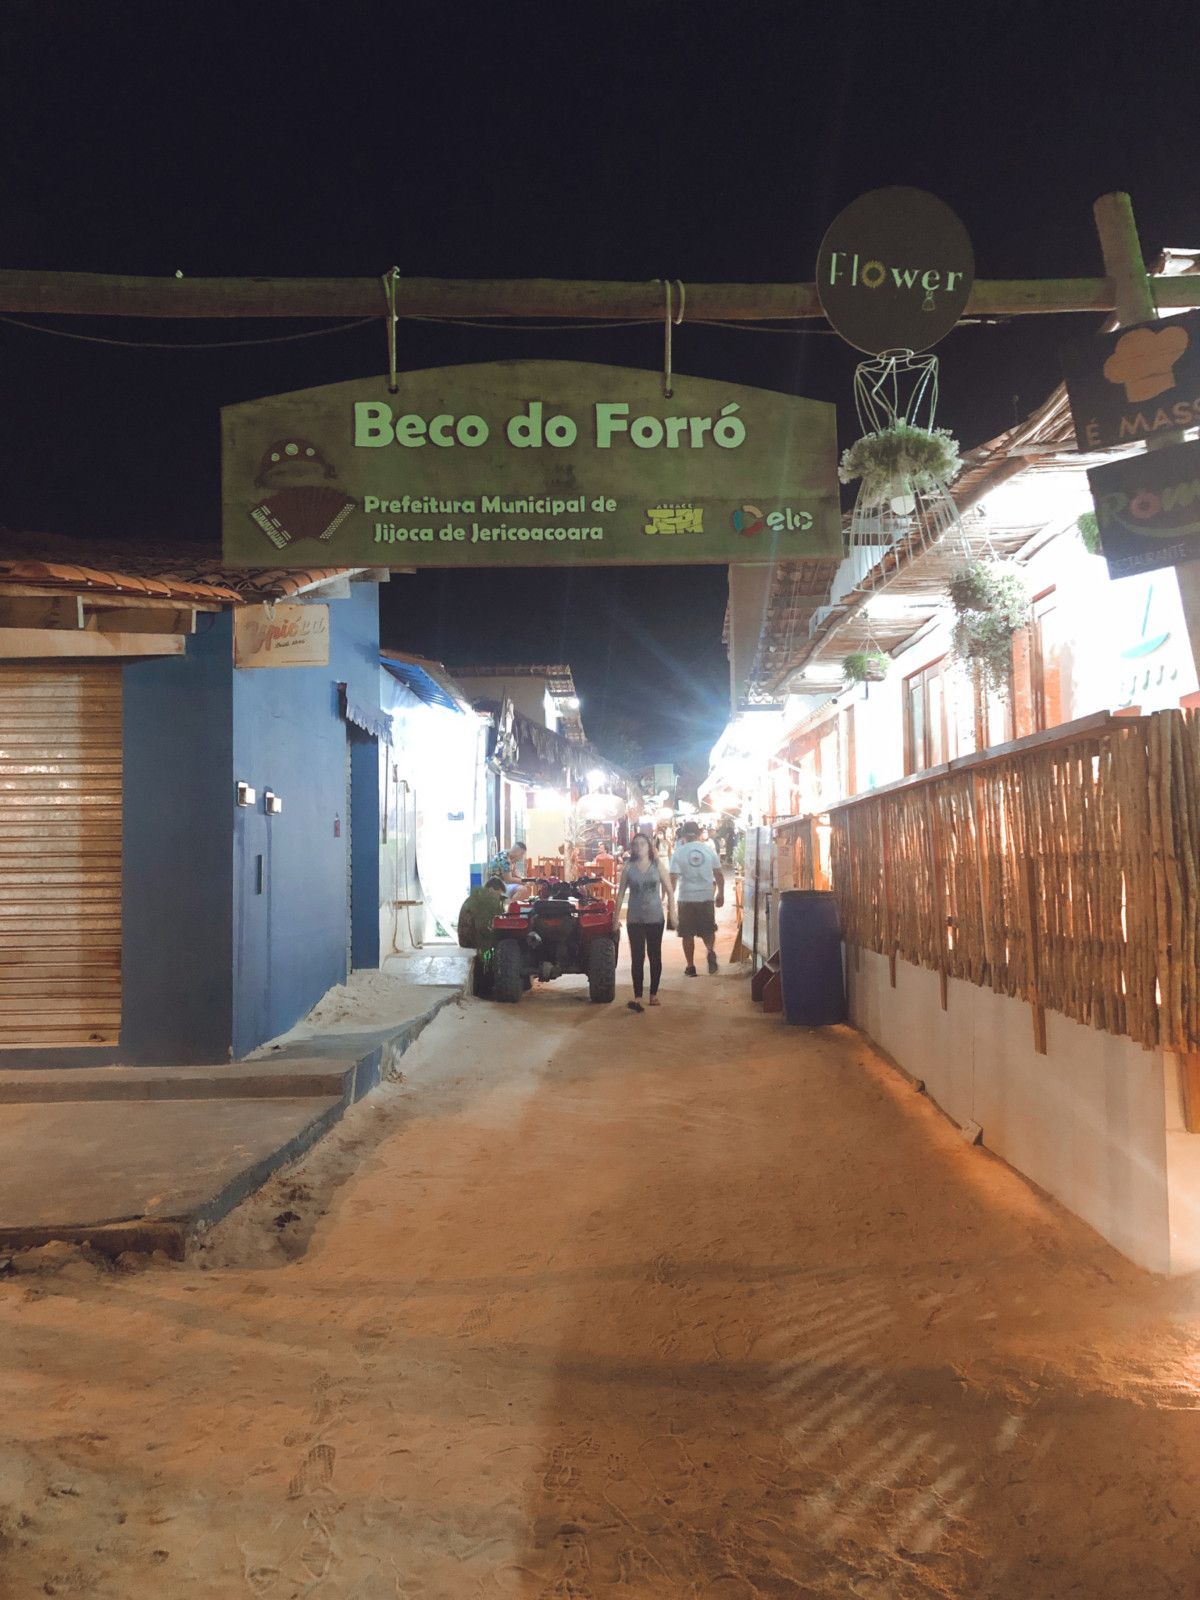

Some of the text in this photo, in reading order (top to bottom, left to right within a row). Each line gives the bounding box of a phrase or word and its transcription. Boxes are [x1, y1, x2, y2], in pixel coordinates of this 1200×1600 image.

[829, 252, 963, 292] Flower
[354, 401, 746, 449] Beco do Forró
[364, 495, 617, 516] Prefeitura Municipal de
[766, 507, 814, 532] elo
[374, 523, 604, 544] Jijoca de Jericoacoara
